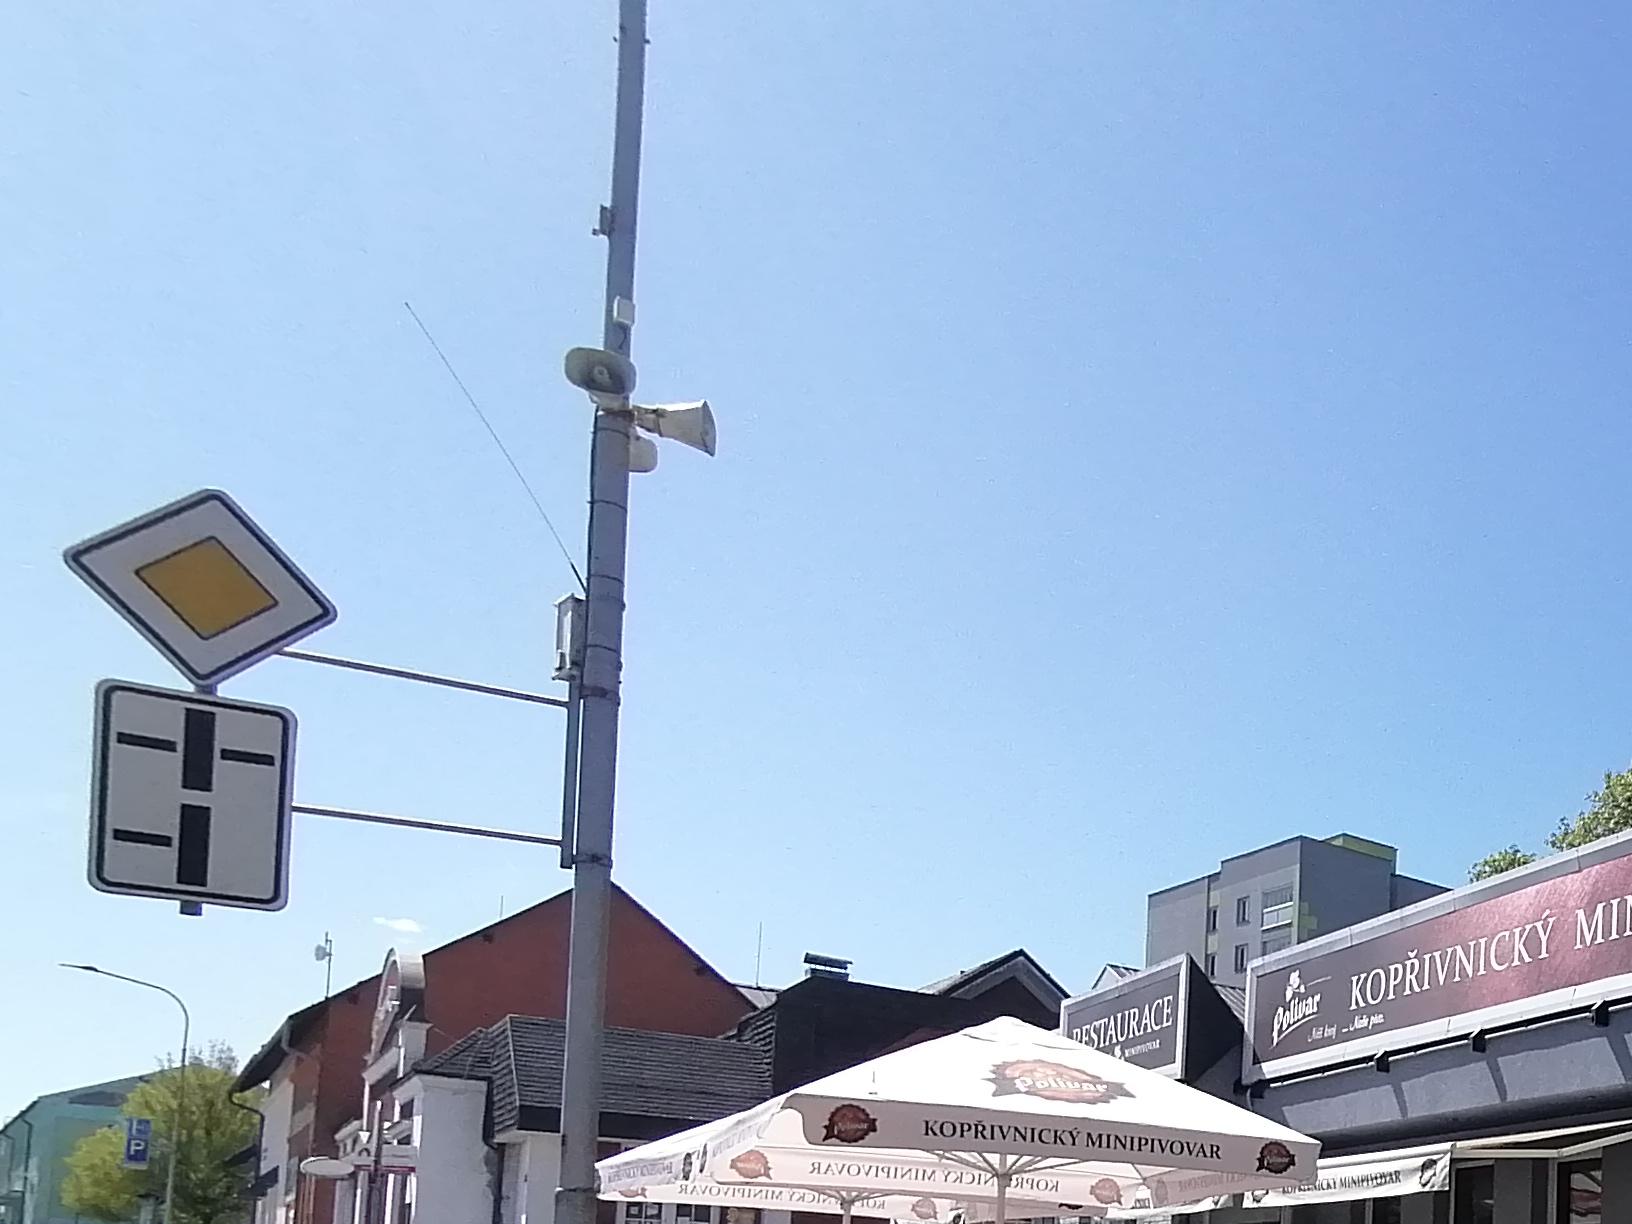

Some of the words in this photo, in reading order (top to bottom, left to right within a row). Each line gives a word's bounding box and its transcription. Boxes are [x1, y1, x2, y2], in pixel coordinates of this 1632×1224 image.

[1349, 909, 1556, 1011] KOPŘIVNICKÝ
[1072, 995, 1173, 1050] RESTAURACE
[130, 1139, 145, 1155] P
[923, 1119, 1080, 1148] KOPŘIVNICKÝ
[1085, 1133, 1222, 1161] MINIPIVOVAR
